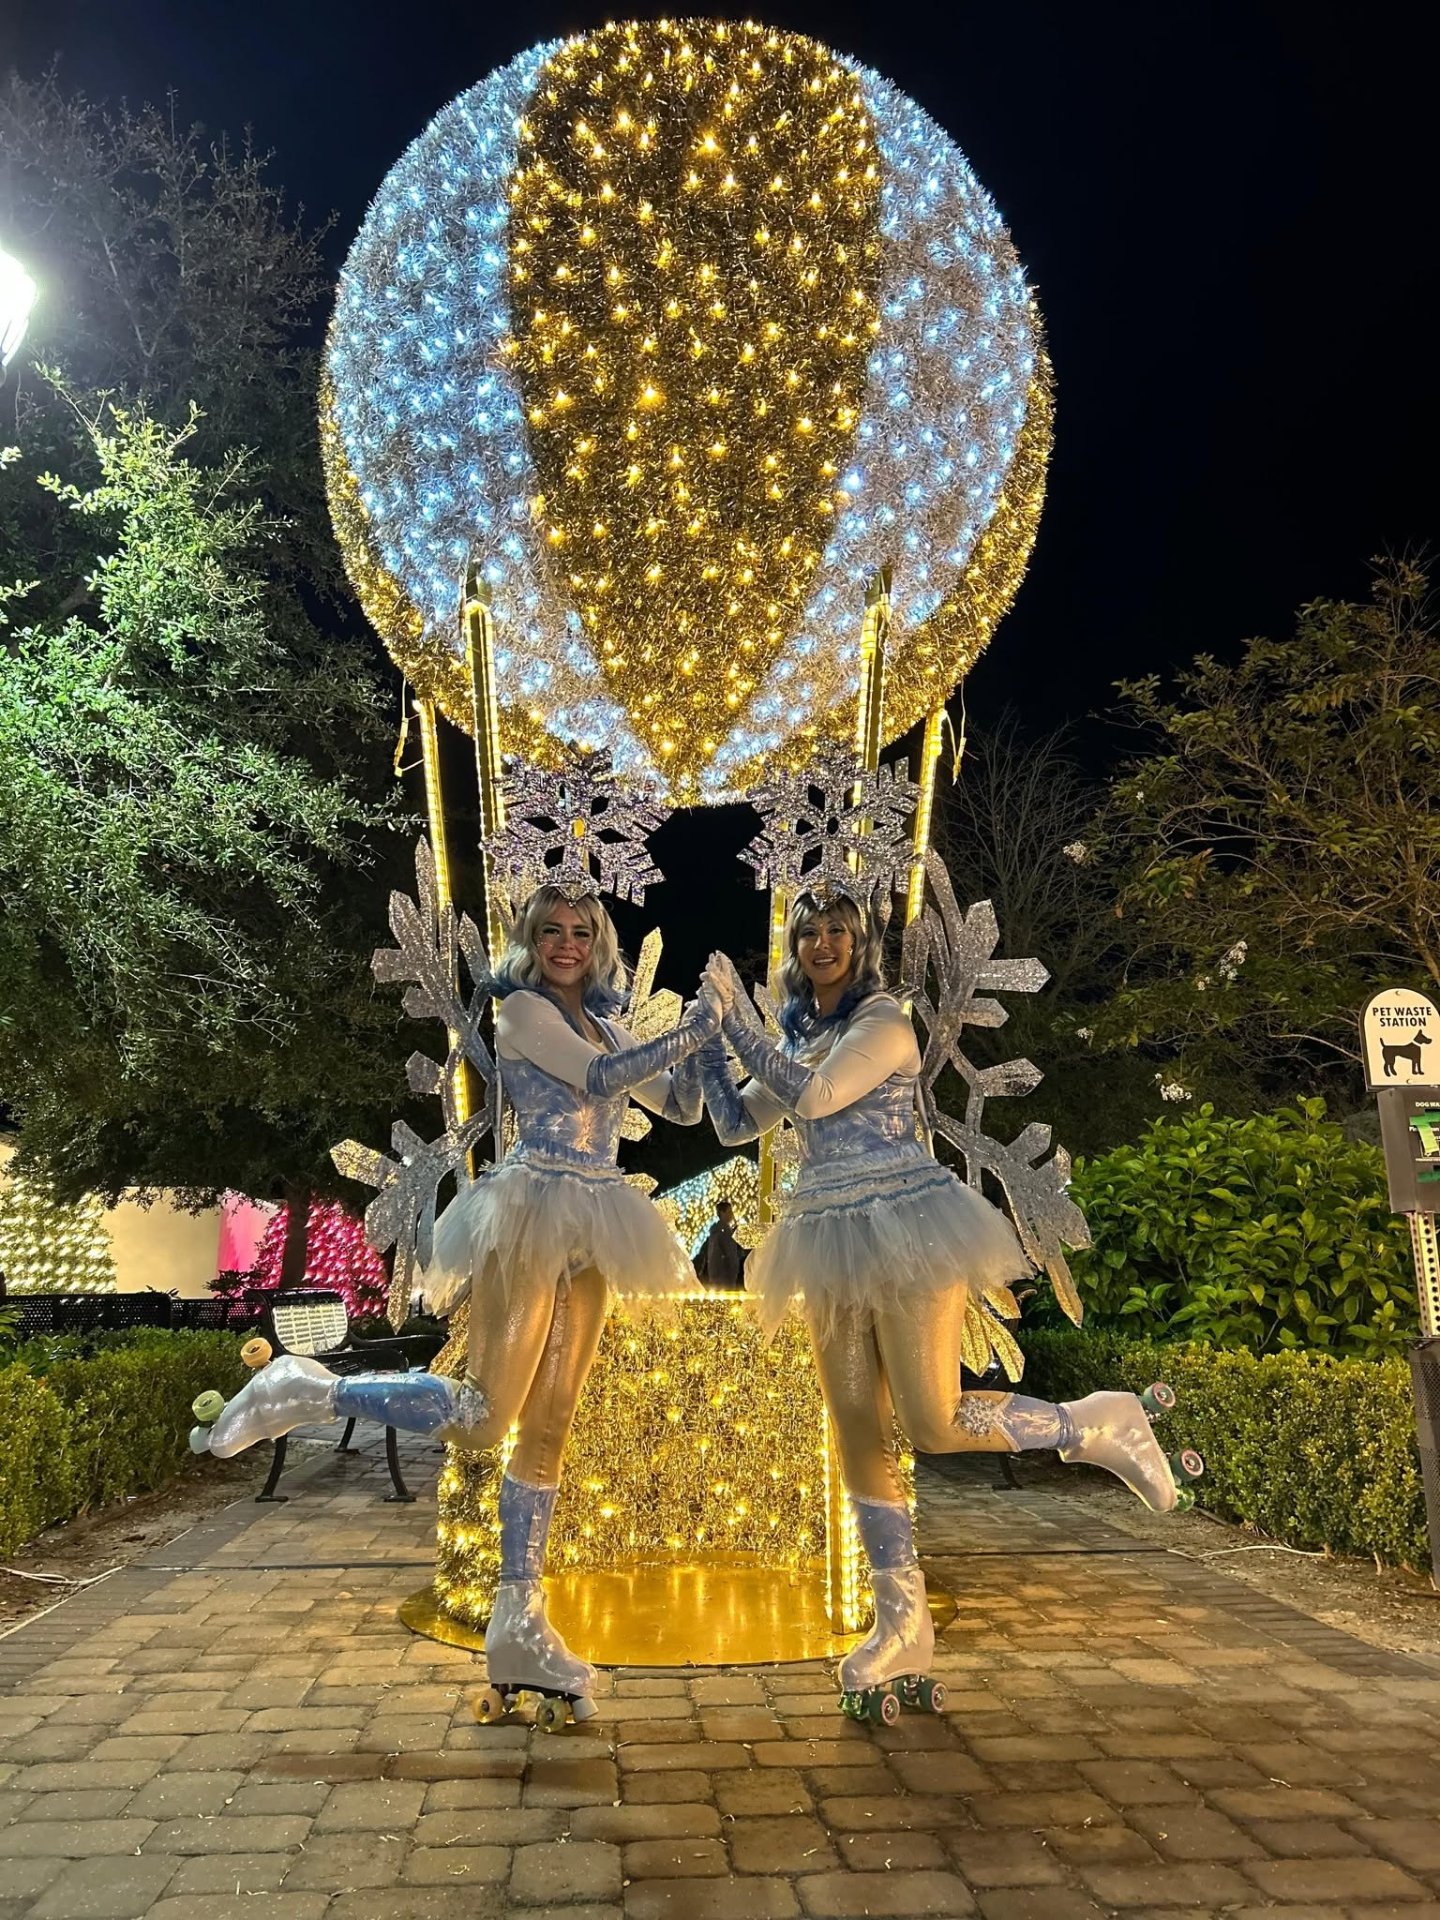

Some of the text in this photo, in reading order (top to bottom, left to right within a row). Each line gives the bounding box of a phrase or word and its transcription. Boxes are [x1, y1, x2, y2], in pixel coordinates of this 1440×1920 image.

[1372, 1006, 1432, 1016] PET WASTE
[1380, 1017, 1427, 1027] STATION
